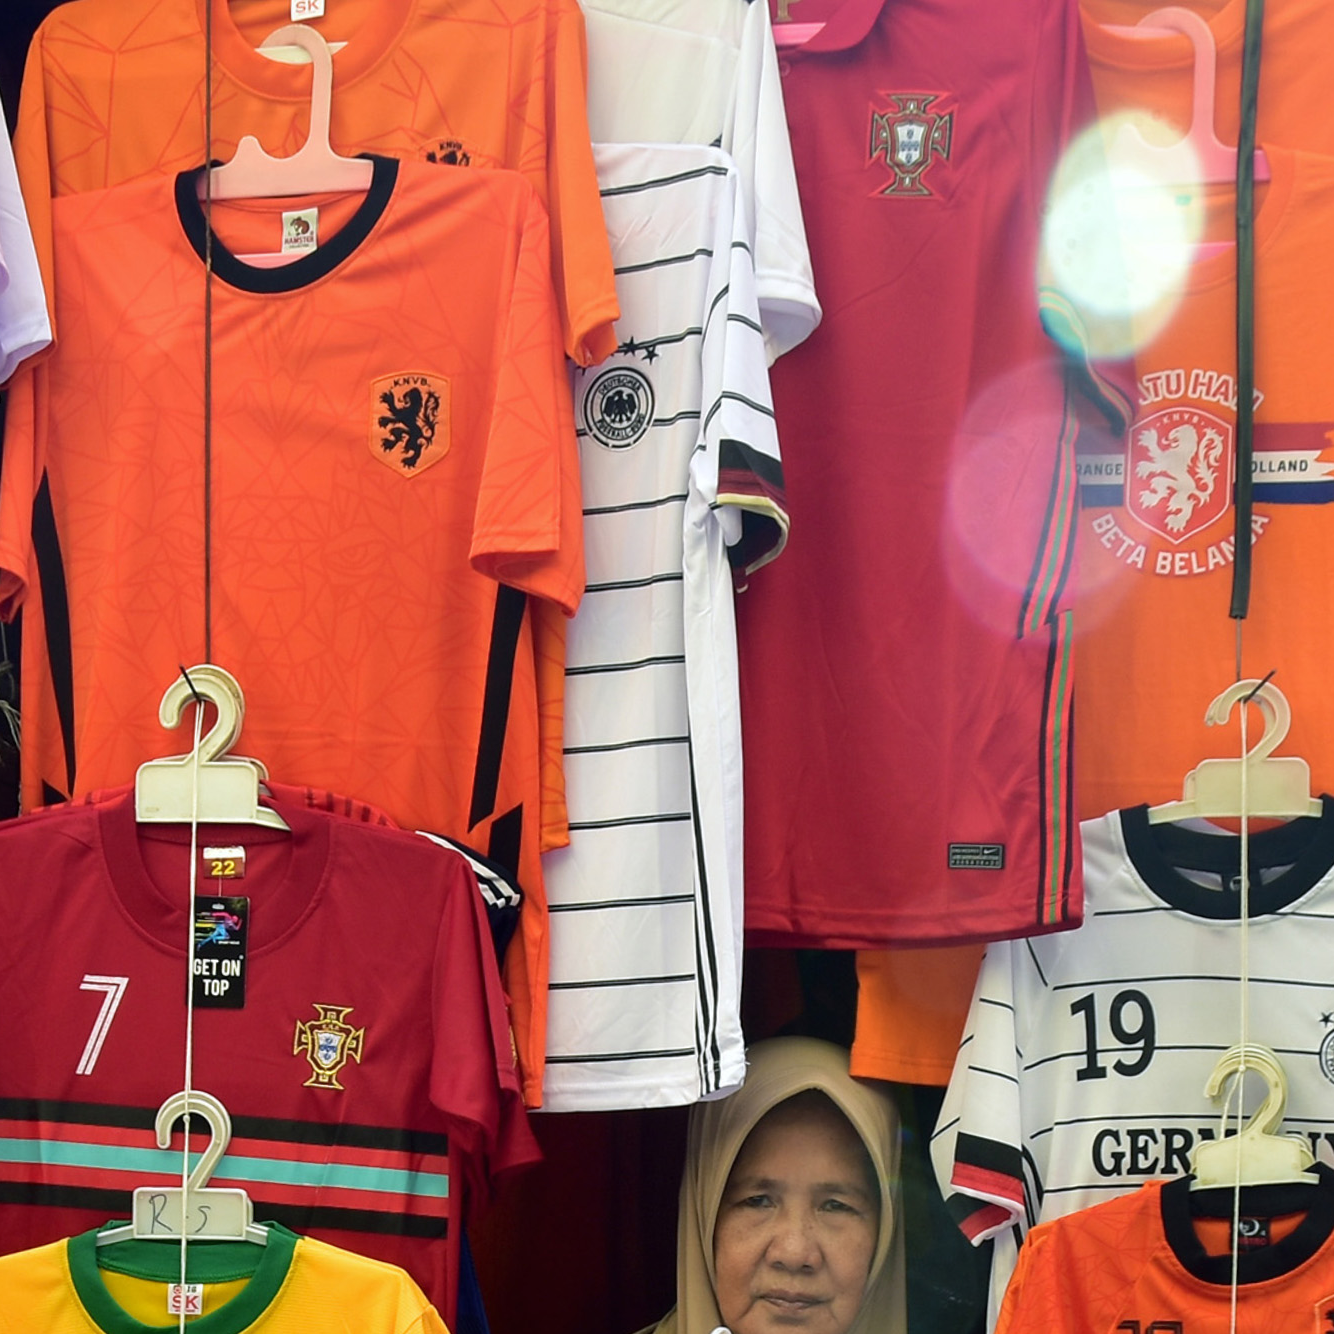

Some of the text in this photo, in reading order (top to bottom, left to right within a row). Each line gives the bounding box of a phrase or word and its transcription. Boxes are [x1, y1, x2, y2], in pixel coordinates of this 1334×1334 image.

[393, 376, 429, 388] KNVB
[1076, 459, 1309, 476] RANGE OLLAND
[1092, 513, 1270, 576] BETA BELANA
[211, 860, 236, 876] 22
[193, 959, 241, 977] GET ON
[203, 978, 230, 996] TOP
[75, 973, 129, 1076] 7
[1070, 989, 1157, 1082] 19
